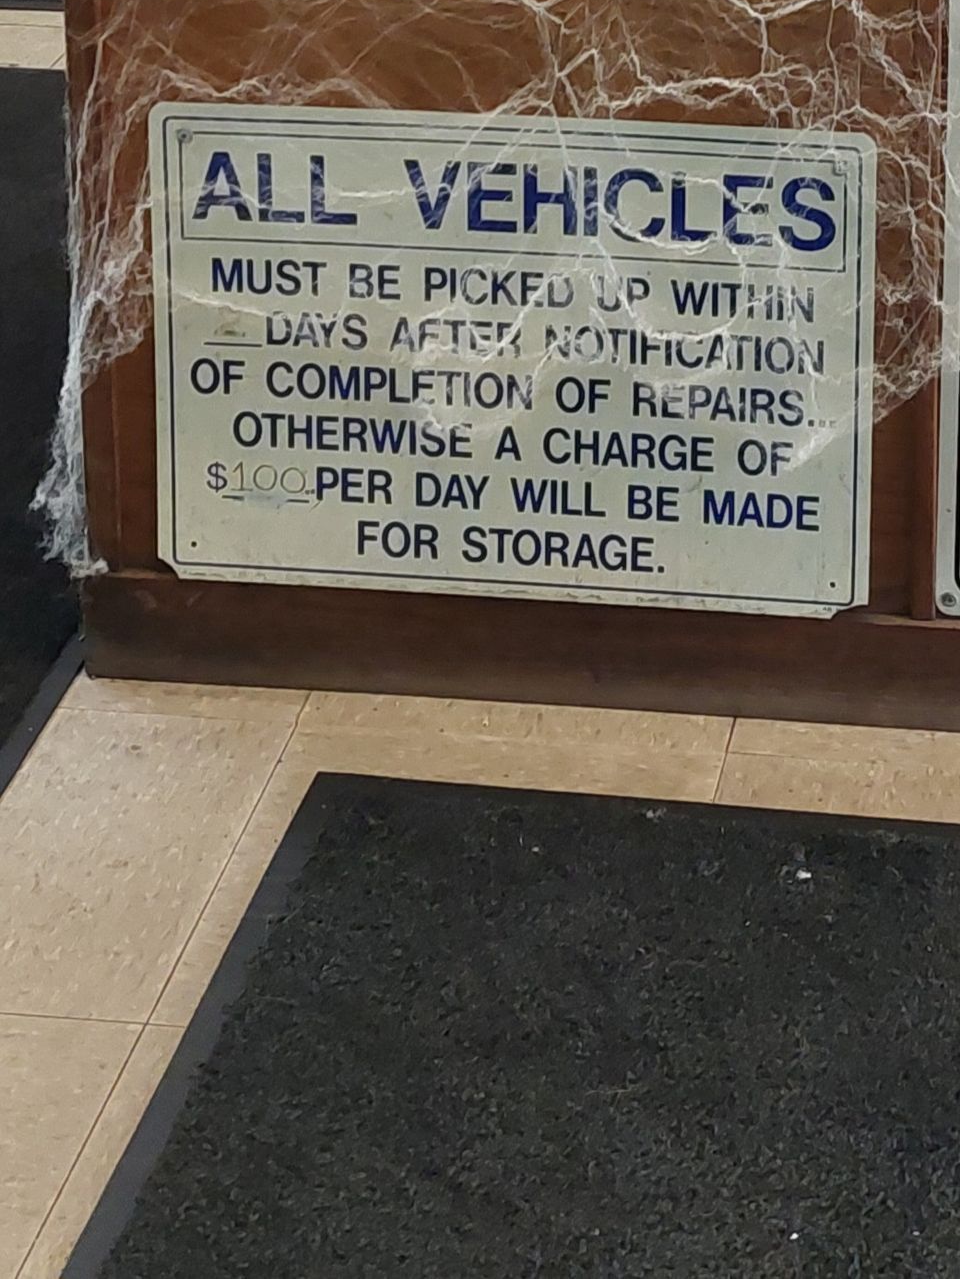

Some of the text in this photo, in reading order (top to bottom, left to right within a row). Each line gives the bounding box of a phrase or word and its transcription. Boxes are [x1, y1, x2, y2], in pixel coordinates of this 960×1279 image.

[191, 151, 837, 252] ALL VEHICLES
[210, 256, 815, 324] MUST BE PICKED UP WITHIN
[265, 310, 369, 351] DAYS
[545, 323, 825, 376] NOTIFICATION
[190, 357, 246, 395] OF
[265, 360, 534, 412] COMPLETION
[555, 375, 612, 416] OF
[232, 410, 794, 478] OTHERWISE A CHARGE OF
[415, 471, 491, 511] DAY
[510, 476, 608, 519] WILL
[627, 484, 681, 523] BE
[702, 488, 821, 532] MADE
[356, 519, 666, 574] FOR STORAGE.
